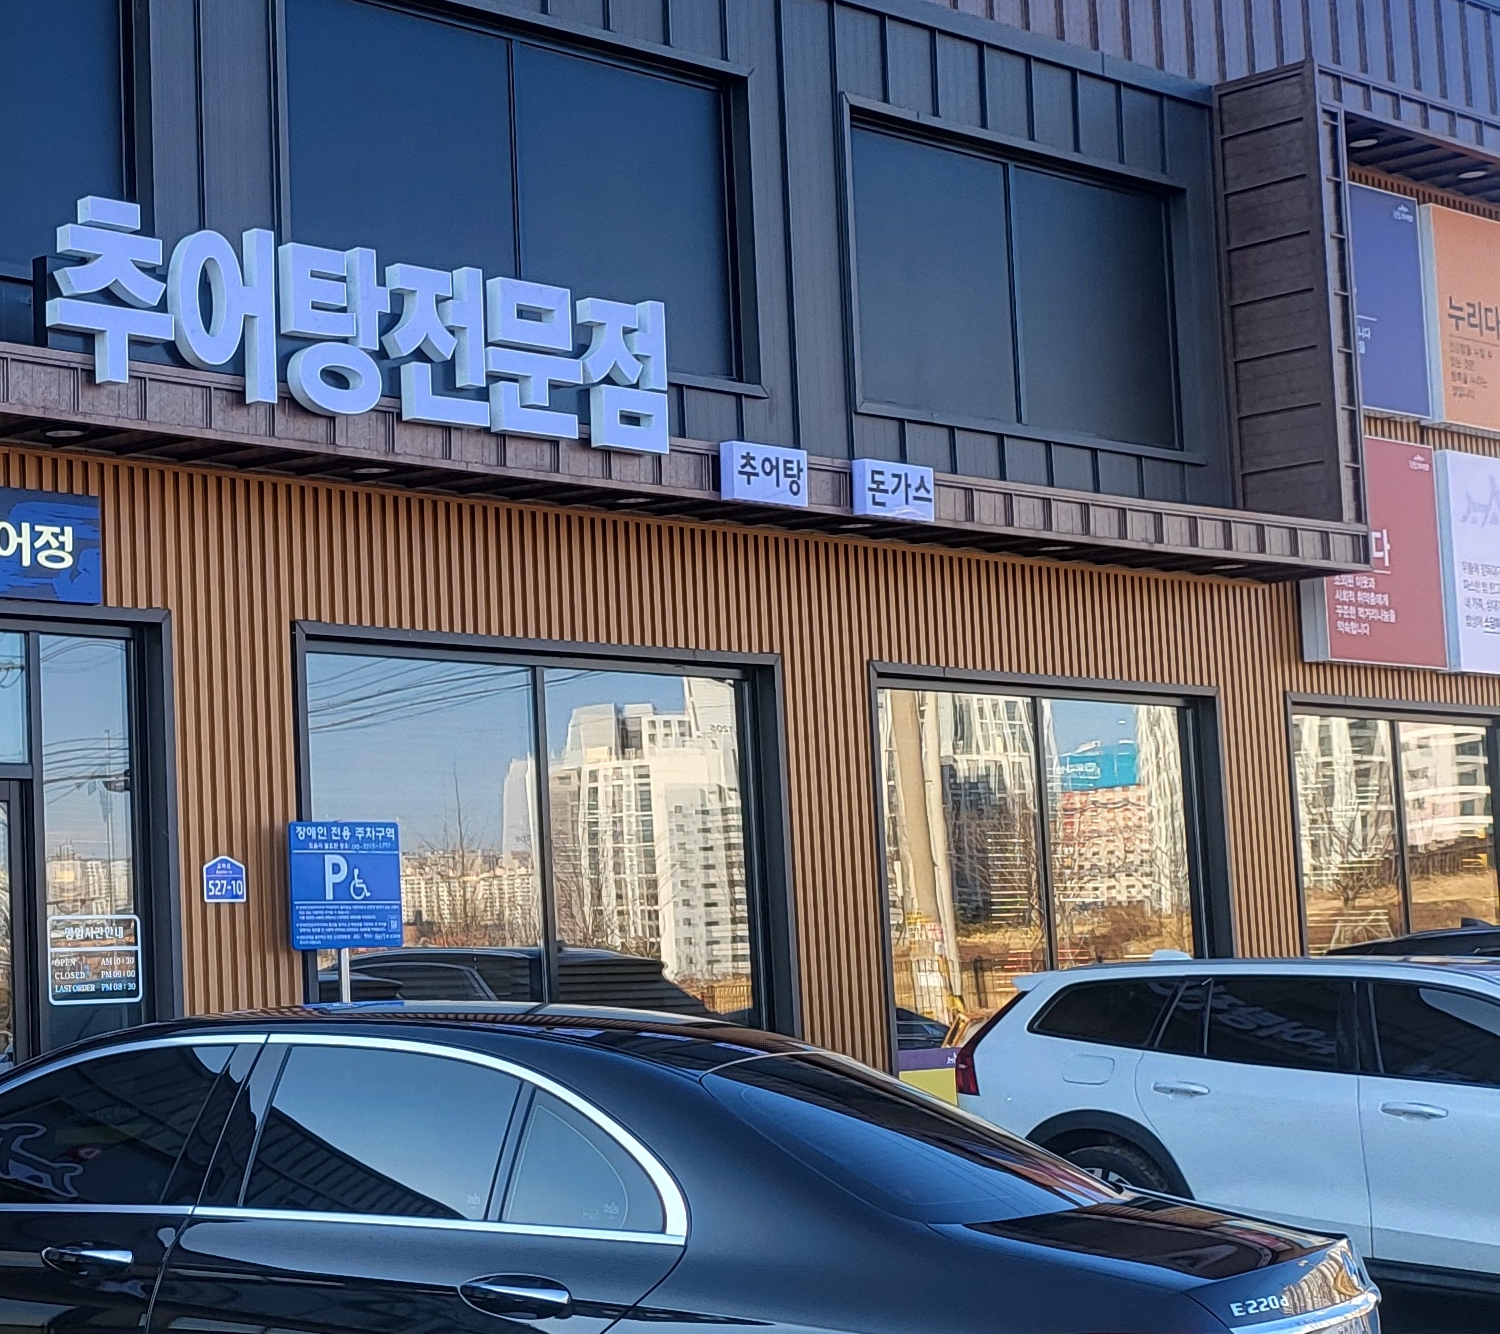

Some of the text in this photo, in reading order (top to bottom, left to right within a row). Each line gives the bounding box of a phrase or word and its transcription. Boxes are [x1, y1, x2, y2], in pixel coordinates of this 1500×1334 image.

[45, 196, 669, 455] 추어탕전문점
[1448, 295, 1500, 341] 누리다
[737, 451, 804, 496] 추어탕
[867, 469, 933, 507] 돈가스
[295, 826, 395, 841] 장애인 전용 주차구역
[324, 854, 348, 900] P
[208, 880, 243, 895] 527-10
[64, 926, 124, 940] 영업시간안내
[54, 958, 77, 967] OPEN
[54, 971, 86, 980] CLOSED
[55, 984, 71, 993] LAST
[72, 983, 96, 992] ORDER
